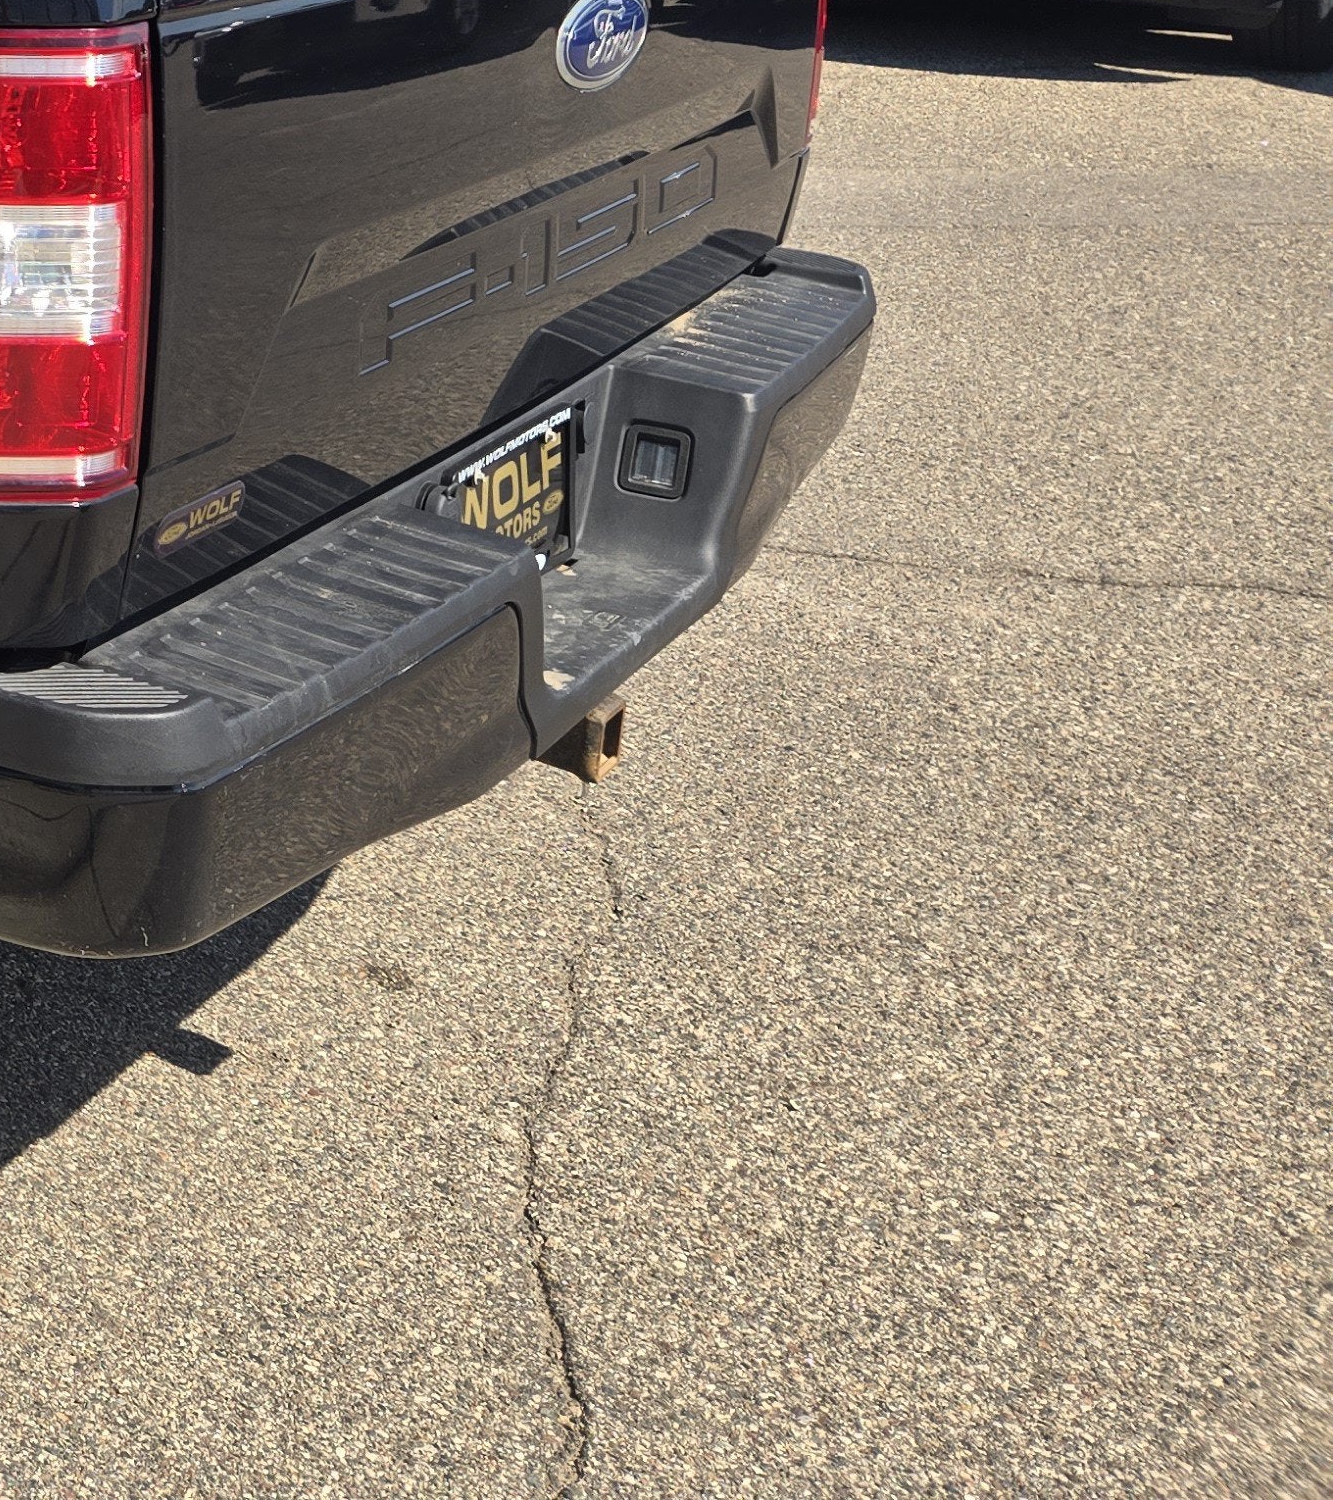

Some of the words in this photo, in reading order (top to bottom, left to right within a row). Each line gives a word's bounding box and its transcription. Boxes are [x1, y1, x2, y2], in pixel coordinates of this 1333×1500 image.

[586, 6, 638, 69] Ford
[359, 144, 718, 376] F-150
[189, 489, 242, 529] WOLF
